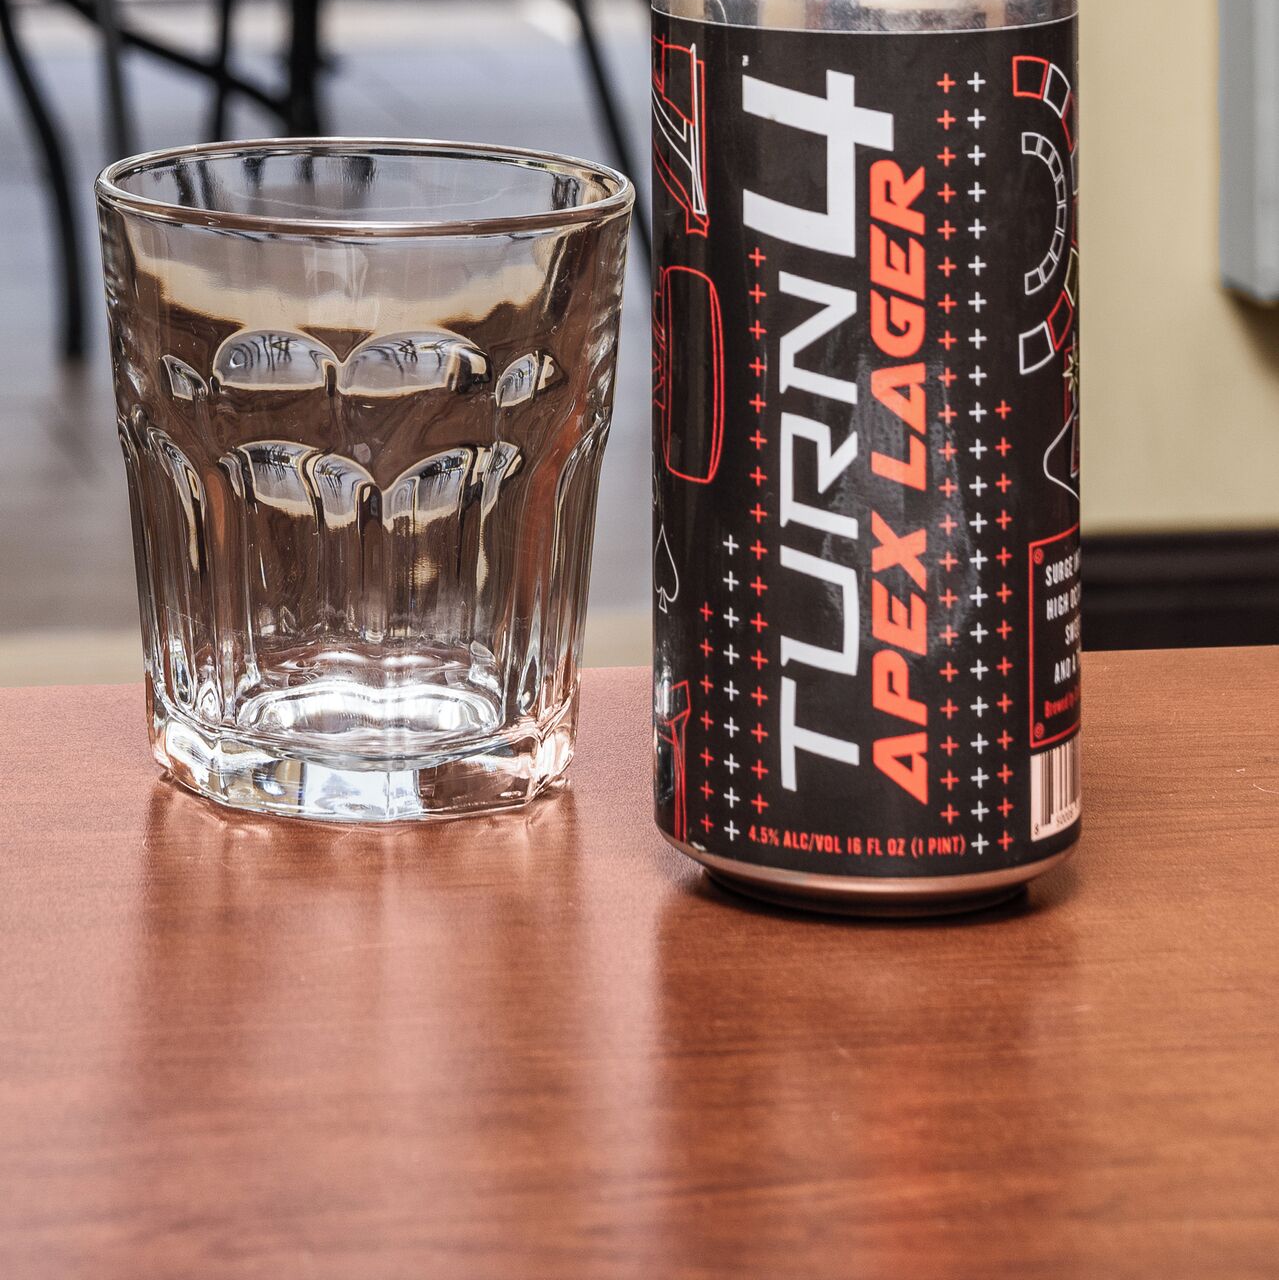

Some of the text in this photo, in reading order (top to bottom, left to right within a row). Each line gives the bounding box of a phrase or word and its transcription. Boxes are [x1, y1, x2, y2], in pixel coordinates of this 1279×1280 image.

[869, 159, 928, 805] APEX LAGER
[1045, 555, 1073, 587] SURGE
[1046, 591, 1069, 621] HIGH
[748, 824, 780, 847] 4.5%
[782, 828, 842, 854] ALC/VOL
[847, 836, 862, 856] 16
[867, 837, 883, 856] FL
[887, 838, 906, 856] OZ
[927, 833, 966, 857] PINT)
